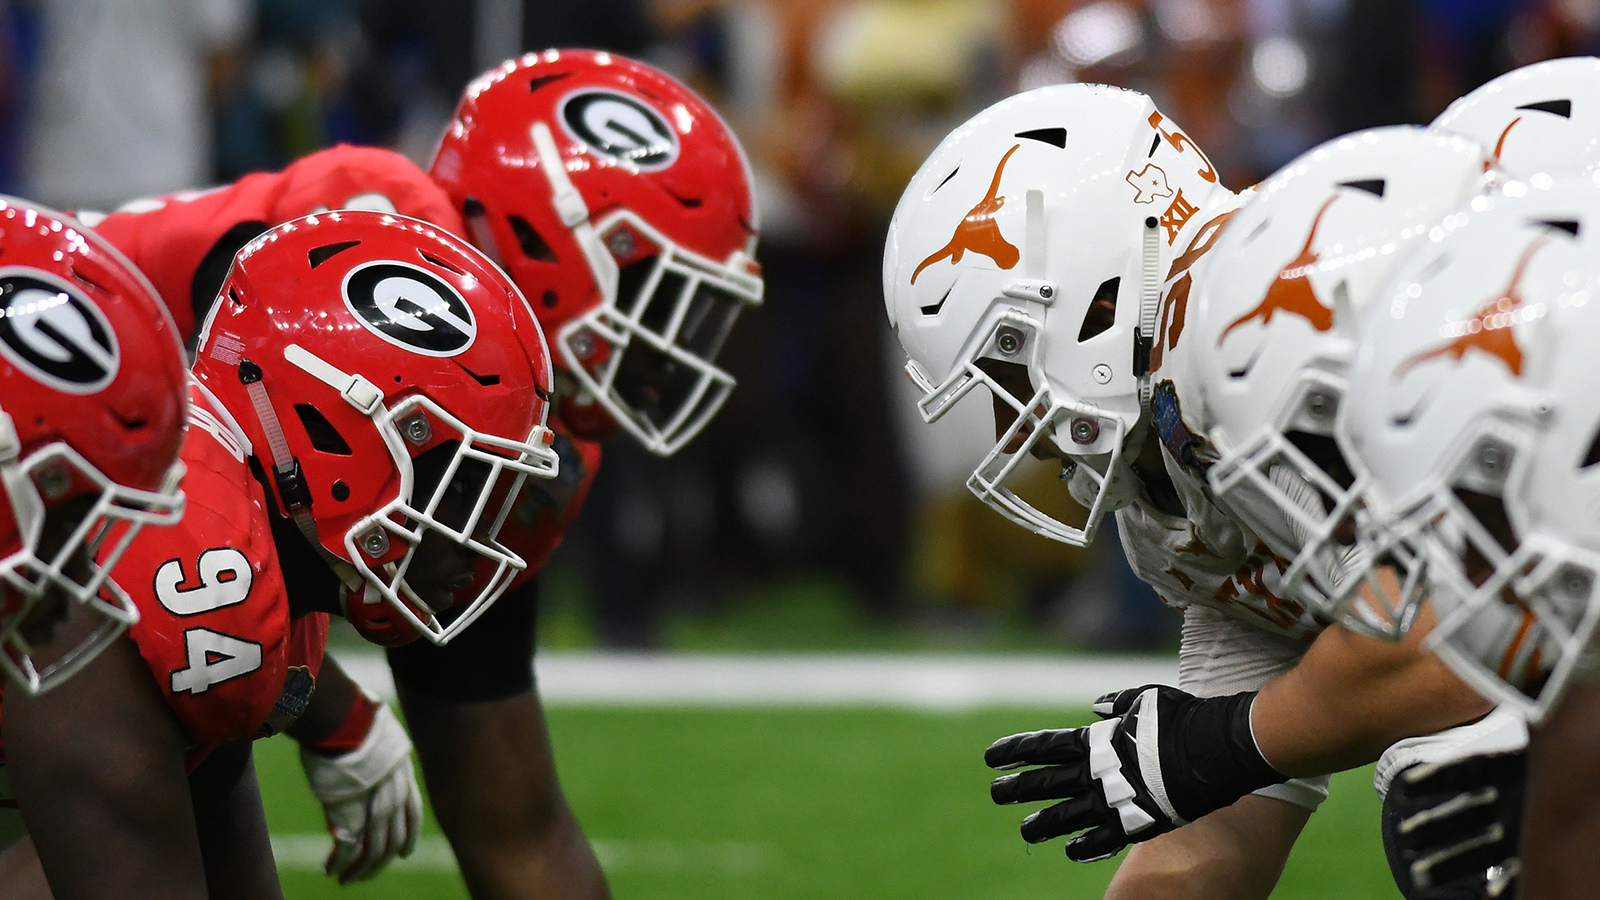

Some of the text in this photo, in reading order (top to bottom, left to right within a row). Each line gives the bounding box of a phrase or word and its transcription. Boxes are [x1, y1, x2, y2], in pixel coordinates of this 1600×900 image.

[561, 90, 675, 167] G
[344, 262, 475, 354] G
[153, 546, 264, 696] 94
